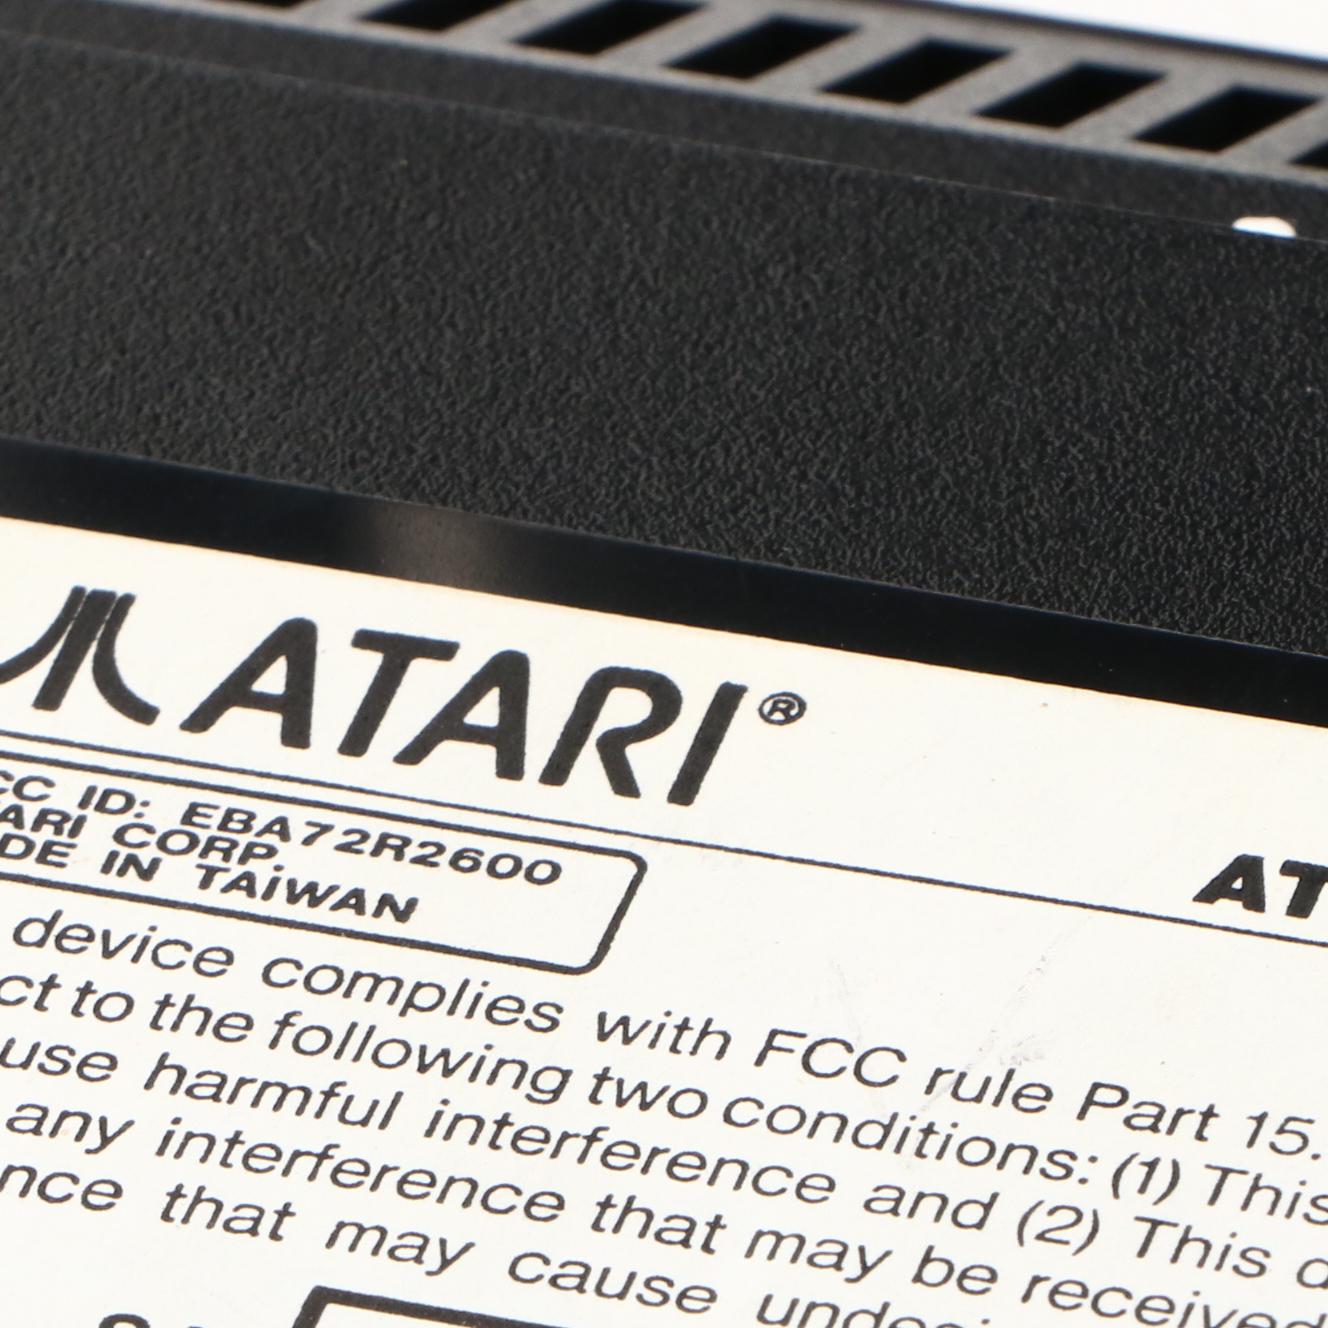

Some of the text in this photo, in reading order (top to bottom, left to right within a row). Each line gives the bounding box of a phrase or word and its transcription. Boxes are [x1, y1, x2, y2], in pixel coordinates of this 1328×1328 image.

[76, 784, 153, 820] ID:
[179, 800, 563, 887] EBA72R2600
[99, 849, 163, 883] IN
[194, 862, 420, 925] TAIWAN
[111, 821, 284, 872] CORP.
[11, 908, 235, 979] device
[260, 956, 565, 1034] complies
[596, 1010, 733, 1062] with
[753, 1027, 908, 1089] FCC
[923, 1066, 1055, 1115] rule
[1075, 1081, 1220, 1143] Part
[1245, 1110, 1323, 1161] 15.
[70, 979, 136, 1024] to
[148, 992, 255, 1044] the
[267, 1009, 574, 1106] following
[587, 1065, 709, 1120] two
[722, 1096, 1100, 1186] conditions:
[1110, 1152, 1181, 1206] (1)
[4, 1102, 136, 1156] any
[154, 1116, 566, 1223] interference
[590, 1193, 728, 1256] that
[744, 1229, 893, 1284] may
[910, 1244, 999, 1296] be
[142, 1051, 405, 1131] harmful
[423, 1103, 837, 1205] interference
[862, 1184, 1001, 1231] and
[1016, 1199, 1101, 1256] (2)
[1133, 1215, 1267, 1279] This
[159, 1182, 297, 1243] that
[324, 1220, 476, 1277] may
[507, 1251, 718, 1315] cause
